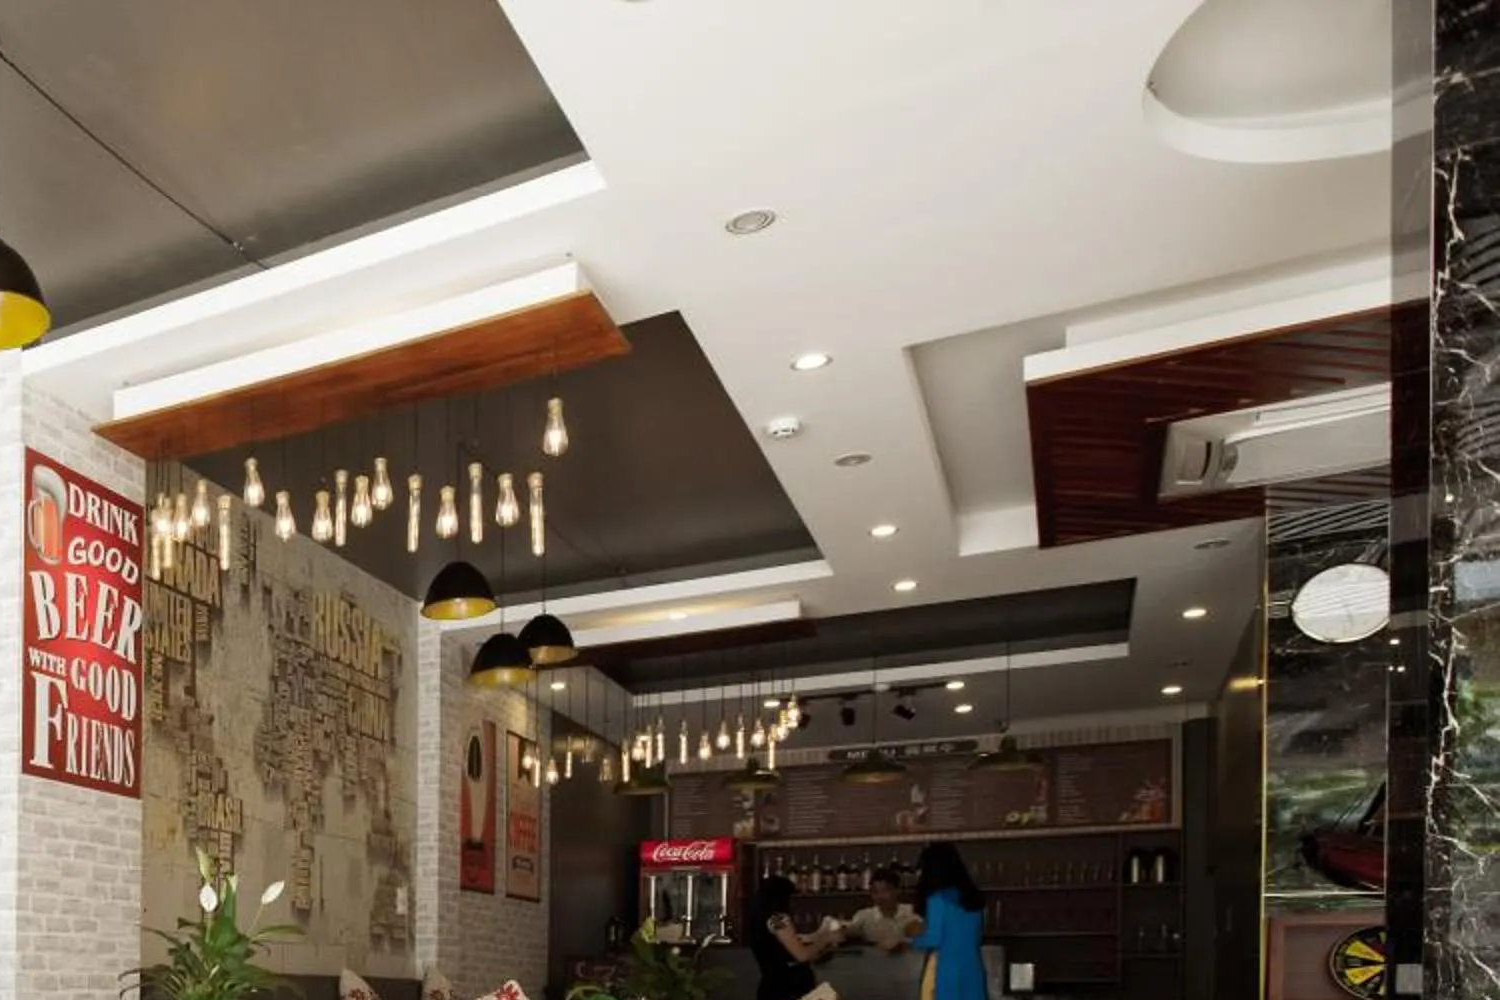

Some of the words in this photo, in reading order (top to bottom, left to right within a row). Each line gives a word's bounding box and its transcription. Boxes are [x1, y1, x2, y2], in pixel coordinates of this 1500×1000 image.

[67, 482, 140, 548] DRINK
[67, 536, 140, 586] GOOD
[29, 569, 143, 665] BEER
[311, 591, 384, 681] RUSSIA
[28, 646, 68, 678] WITH
[70, 656, 138, 722] GOOD
[29, 671, 136, 789] FRIENDS
